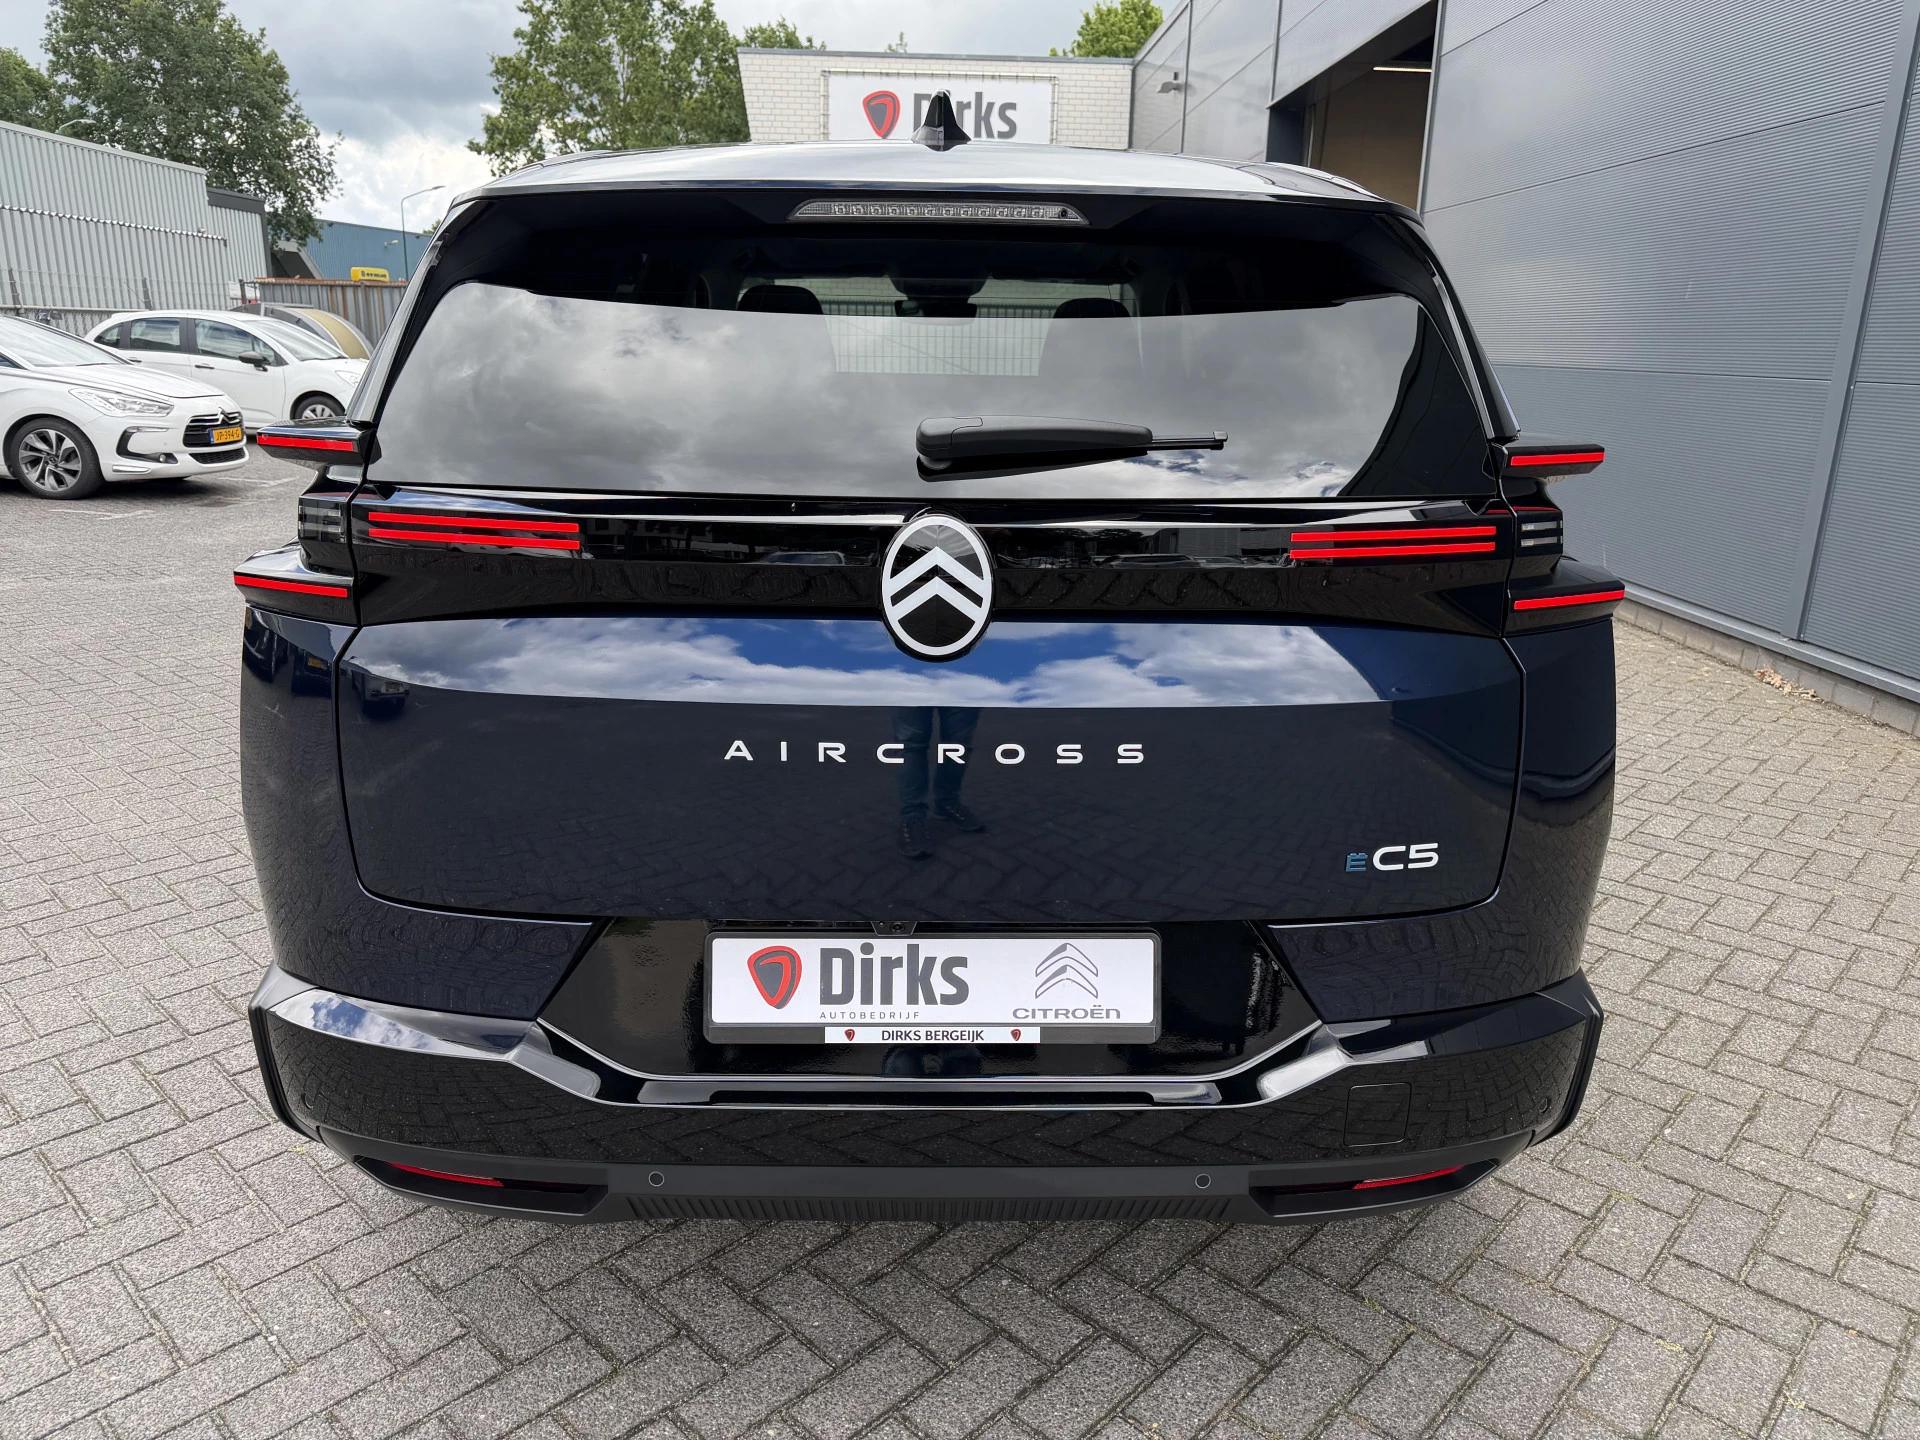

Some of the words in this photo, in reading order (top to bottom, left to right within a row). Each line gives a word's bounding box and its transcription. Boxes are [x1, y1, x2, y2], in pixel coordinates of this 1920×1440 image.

[724, 740, 1145, 765] AIRCROSS
[820, 942, 969, 1005] Dirks
[820, 1011, 920, 1020] AUTOBEDRIJF
[1012, 1004, 1121, 1019] CITROËN
[881, 1030, 921, 1041] DIRKS
[925, 1030, 984, 1042] BERGEIJK
